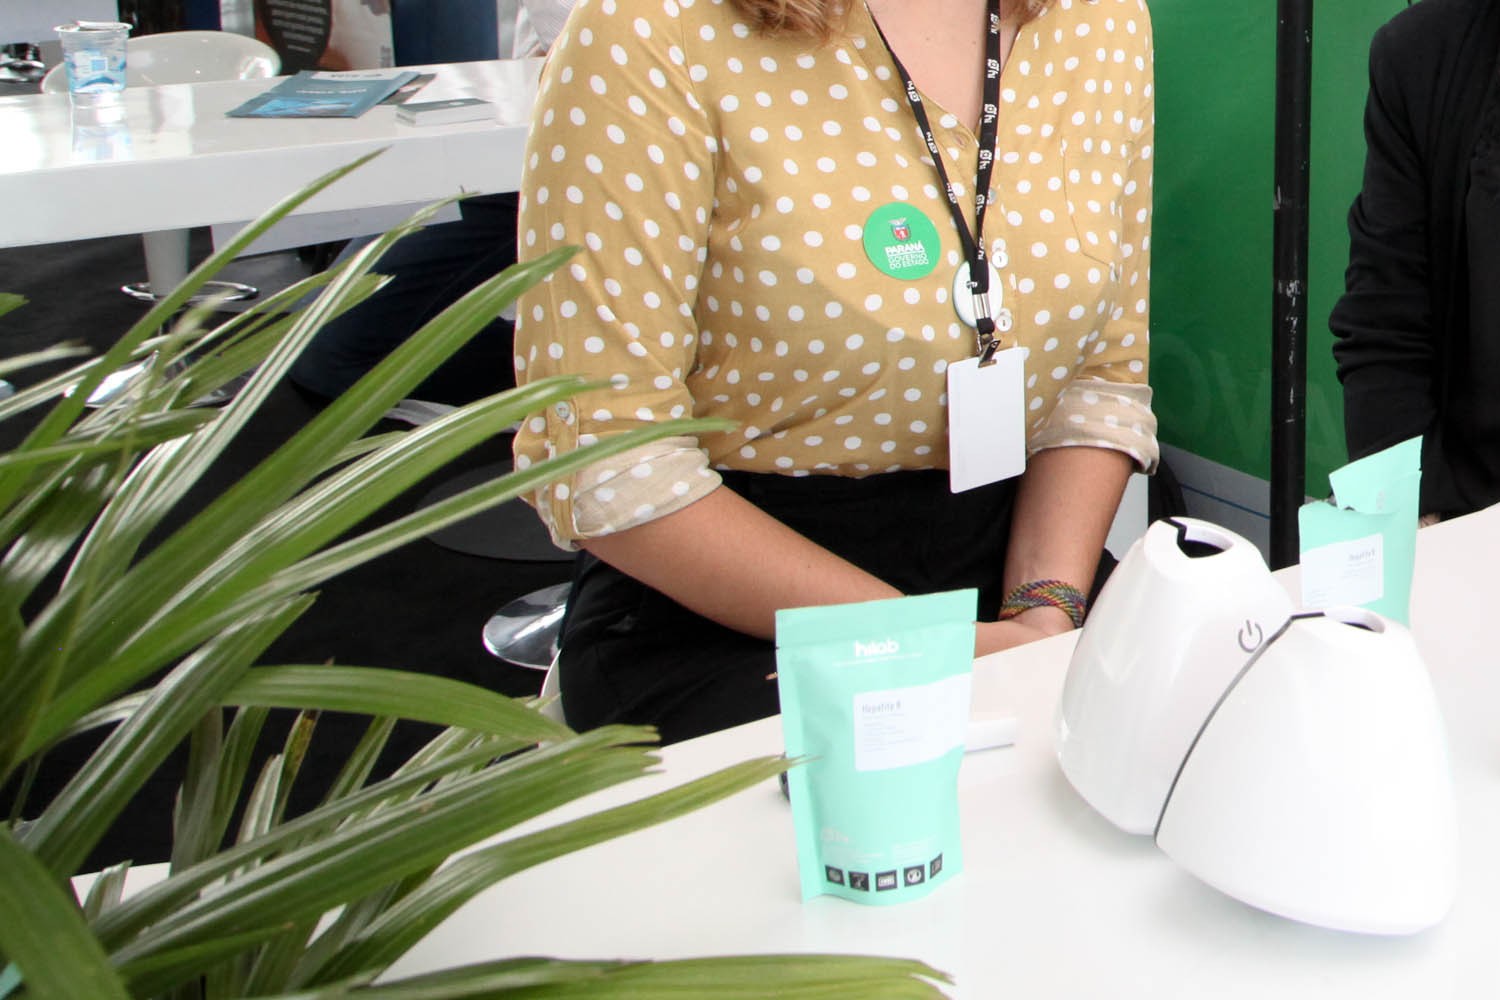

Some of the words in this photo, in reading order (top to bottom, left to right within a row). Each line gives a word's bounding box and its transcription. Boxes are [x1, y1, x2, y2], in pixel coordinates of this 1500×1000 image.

[884, 240, 925, 256] PARANÁ
[889, 260, 902, 270] DO
[853, 639, 899, 657] hilab
